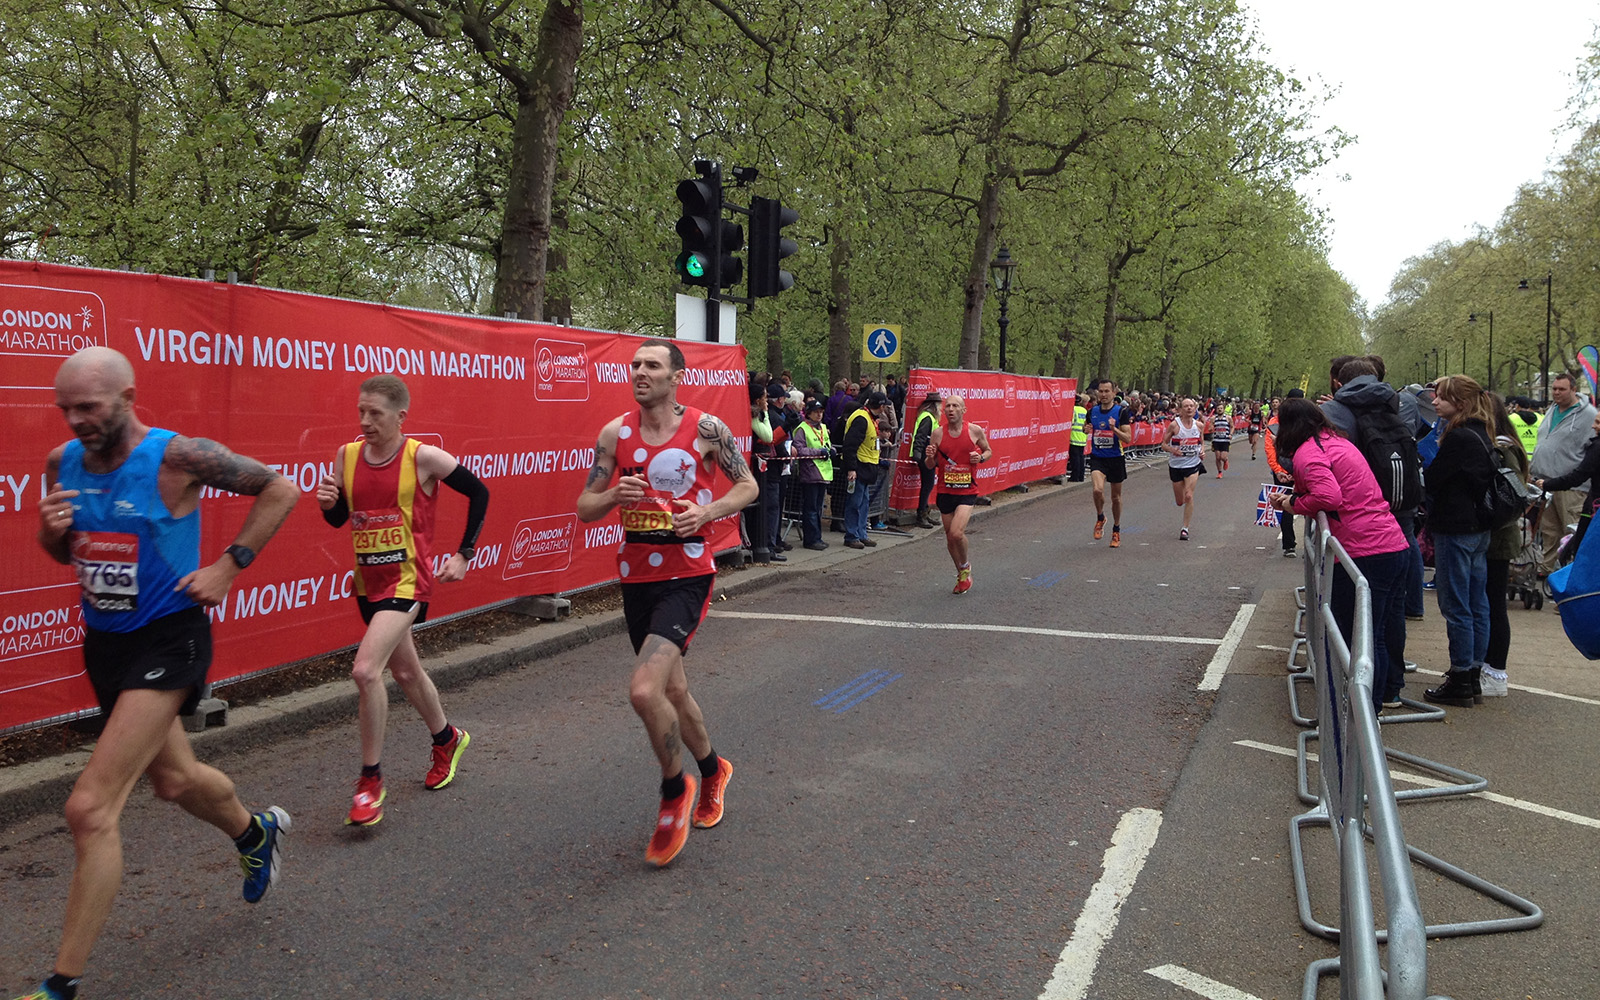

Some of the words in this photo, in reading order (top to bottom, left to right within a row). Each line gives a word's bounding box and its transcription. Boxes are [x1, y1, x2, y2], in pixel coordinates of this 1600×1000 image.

[0, 309, 72, 330] ONDON
[134, 326, 244, 366] VIRGIN
[253, 336, 336, 371] MONEY
[343, 343, 425, 376] LONDON
[430, 350, 525, 380] MARATHON
[554, 355, 579, 366] LONDON
[555, 367, 586, 379] MARATHON
[594, 362, 628, 383] VIRGIN
[511, 450, 561, 476] MONEY
[562, 447, 595, 471] LOND
[368, 514, 399, 522] money
[354, 528, 403, 549] 29746
[533, 528, 563, 542] LONDON
[584, 524, 624, 549] VIRGIN
[91, 542, 135, 555] money
[529, 539, 569, 553] MARATHON
[234, 575, 325, 620] MONEY
[0, 607, 69, 634] ONDON
